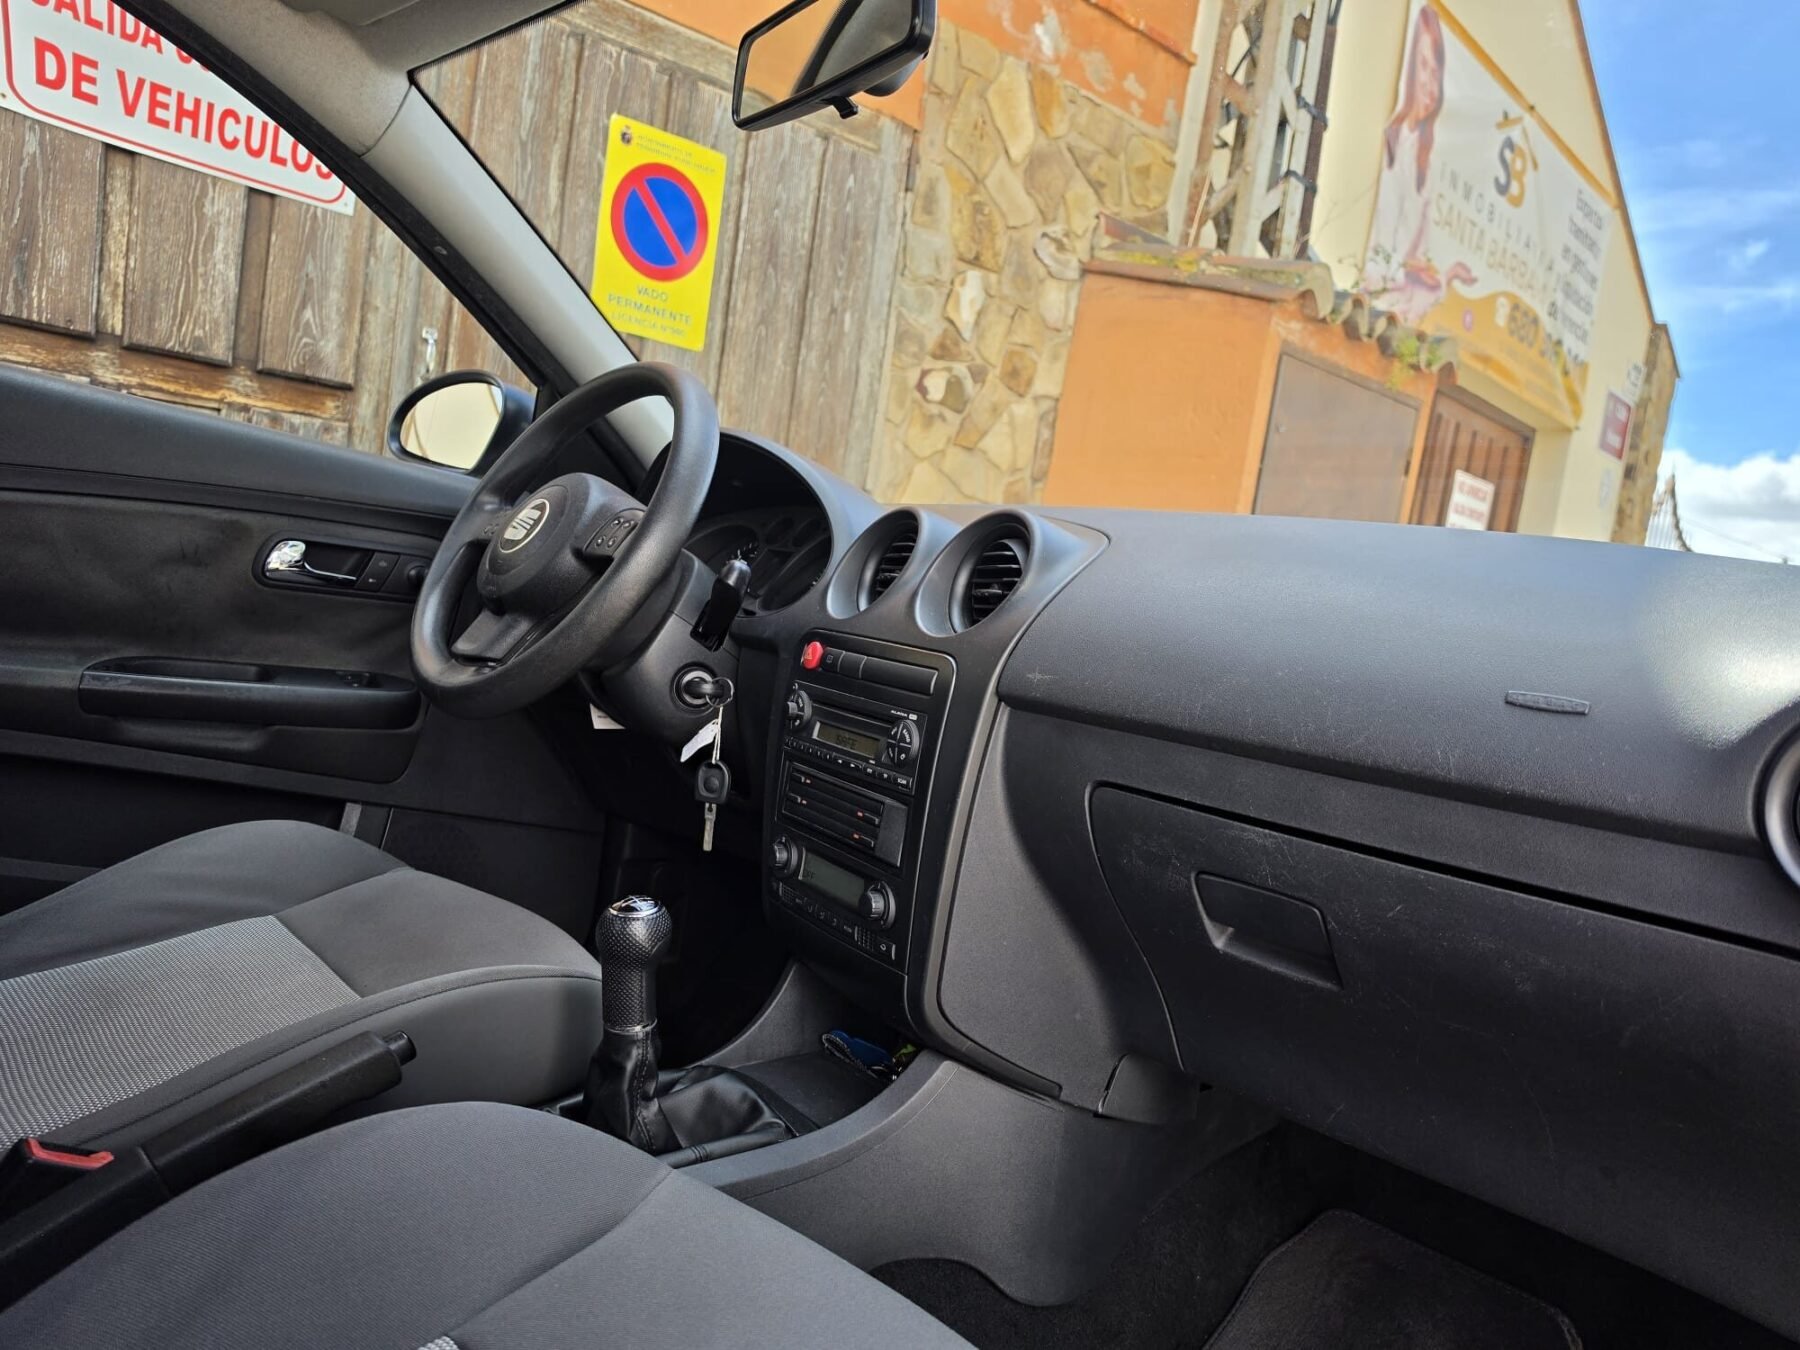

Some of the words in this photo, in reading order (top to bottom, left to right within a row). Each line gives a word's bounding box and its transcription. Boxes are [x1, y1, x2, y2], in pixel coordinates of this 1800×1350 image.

[34, 36, 99, 106] DE
[608, 292, 692, 325] PERMANENTE
[637, 285, 669, 302] VADO
